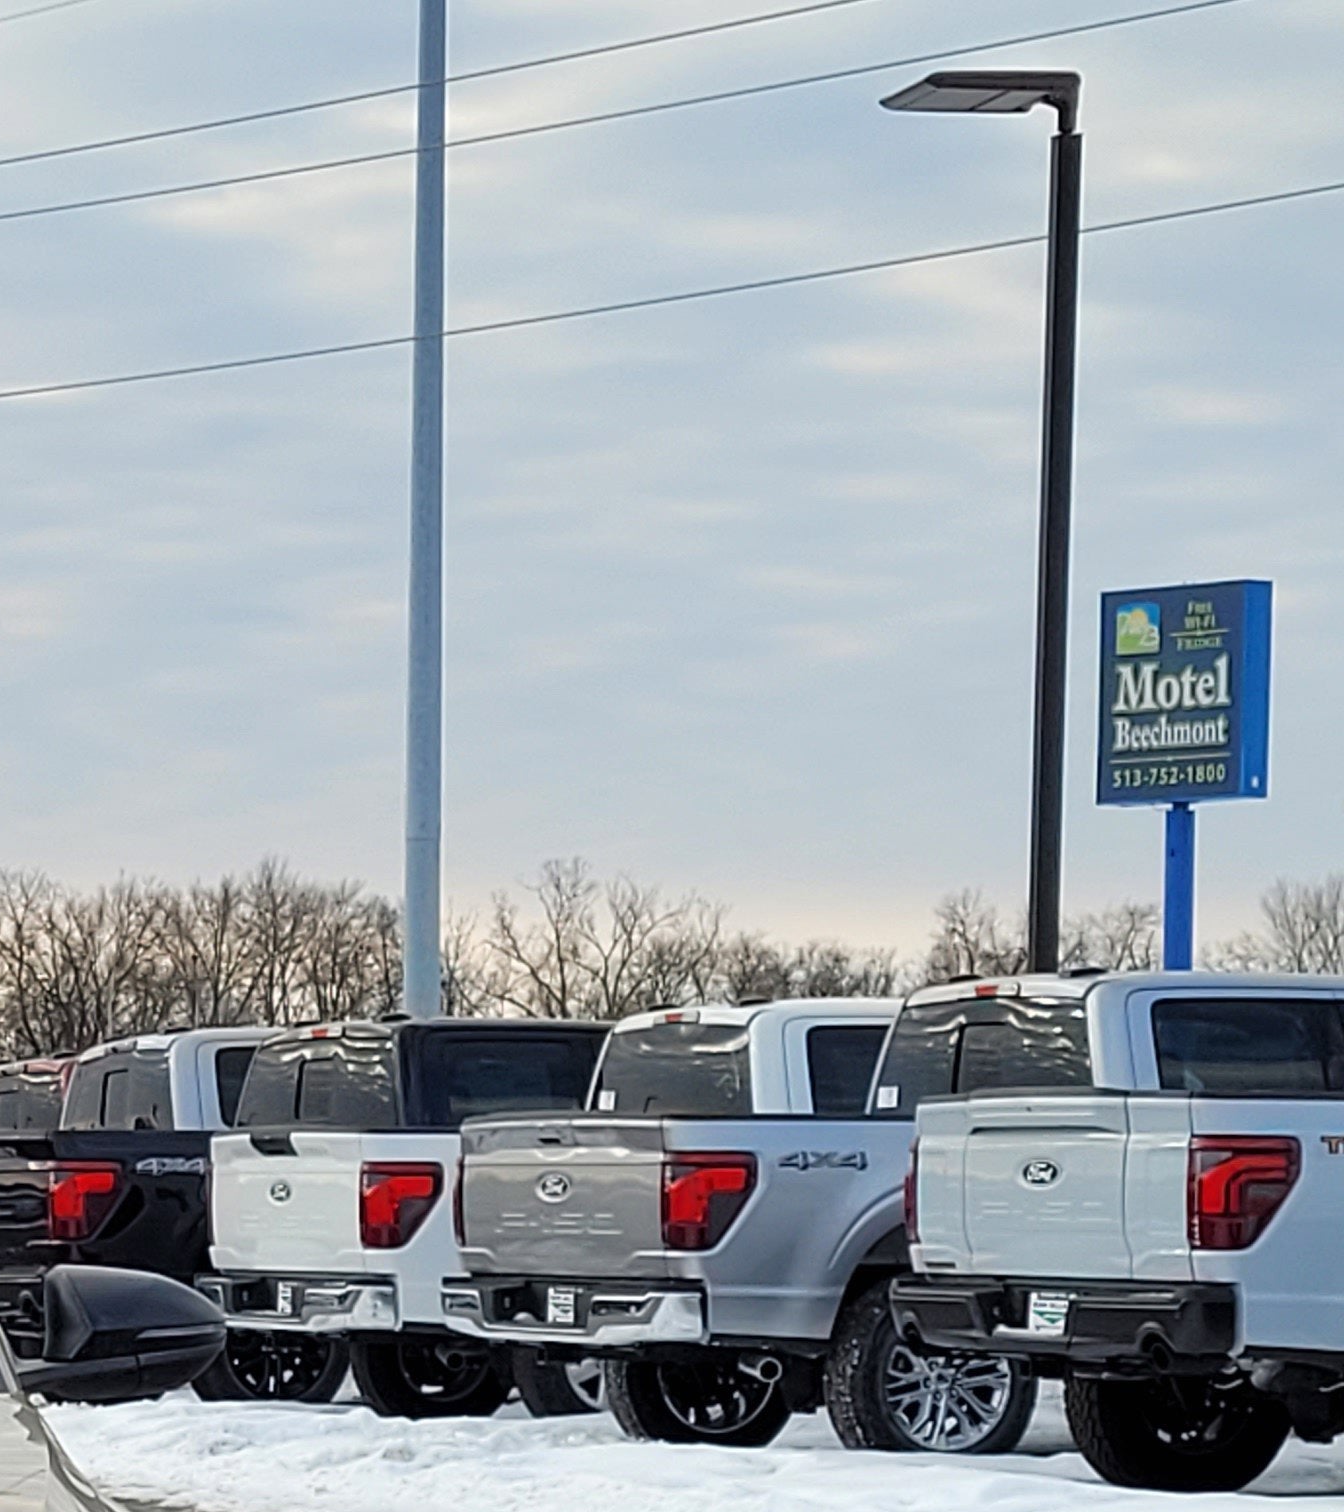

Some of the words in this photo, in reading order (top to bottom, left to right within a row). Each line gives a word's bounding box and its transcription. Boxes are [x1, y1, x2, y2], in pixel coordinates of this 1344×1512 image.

[1114, 654, 1231, 712] Motel
[1114, 715, 1228, 751] Beechmont
[1114, 764, 1225, 787] 513-752-1800
